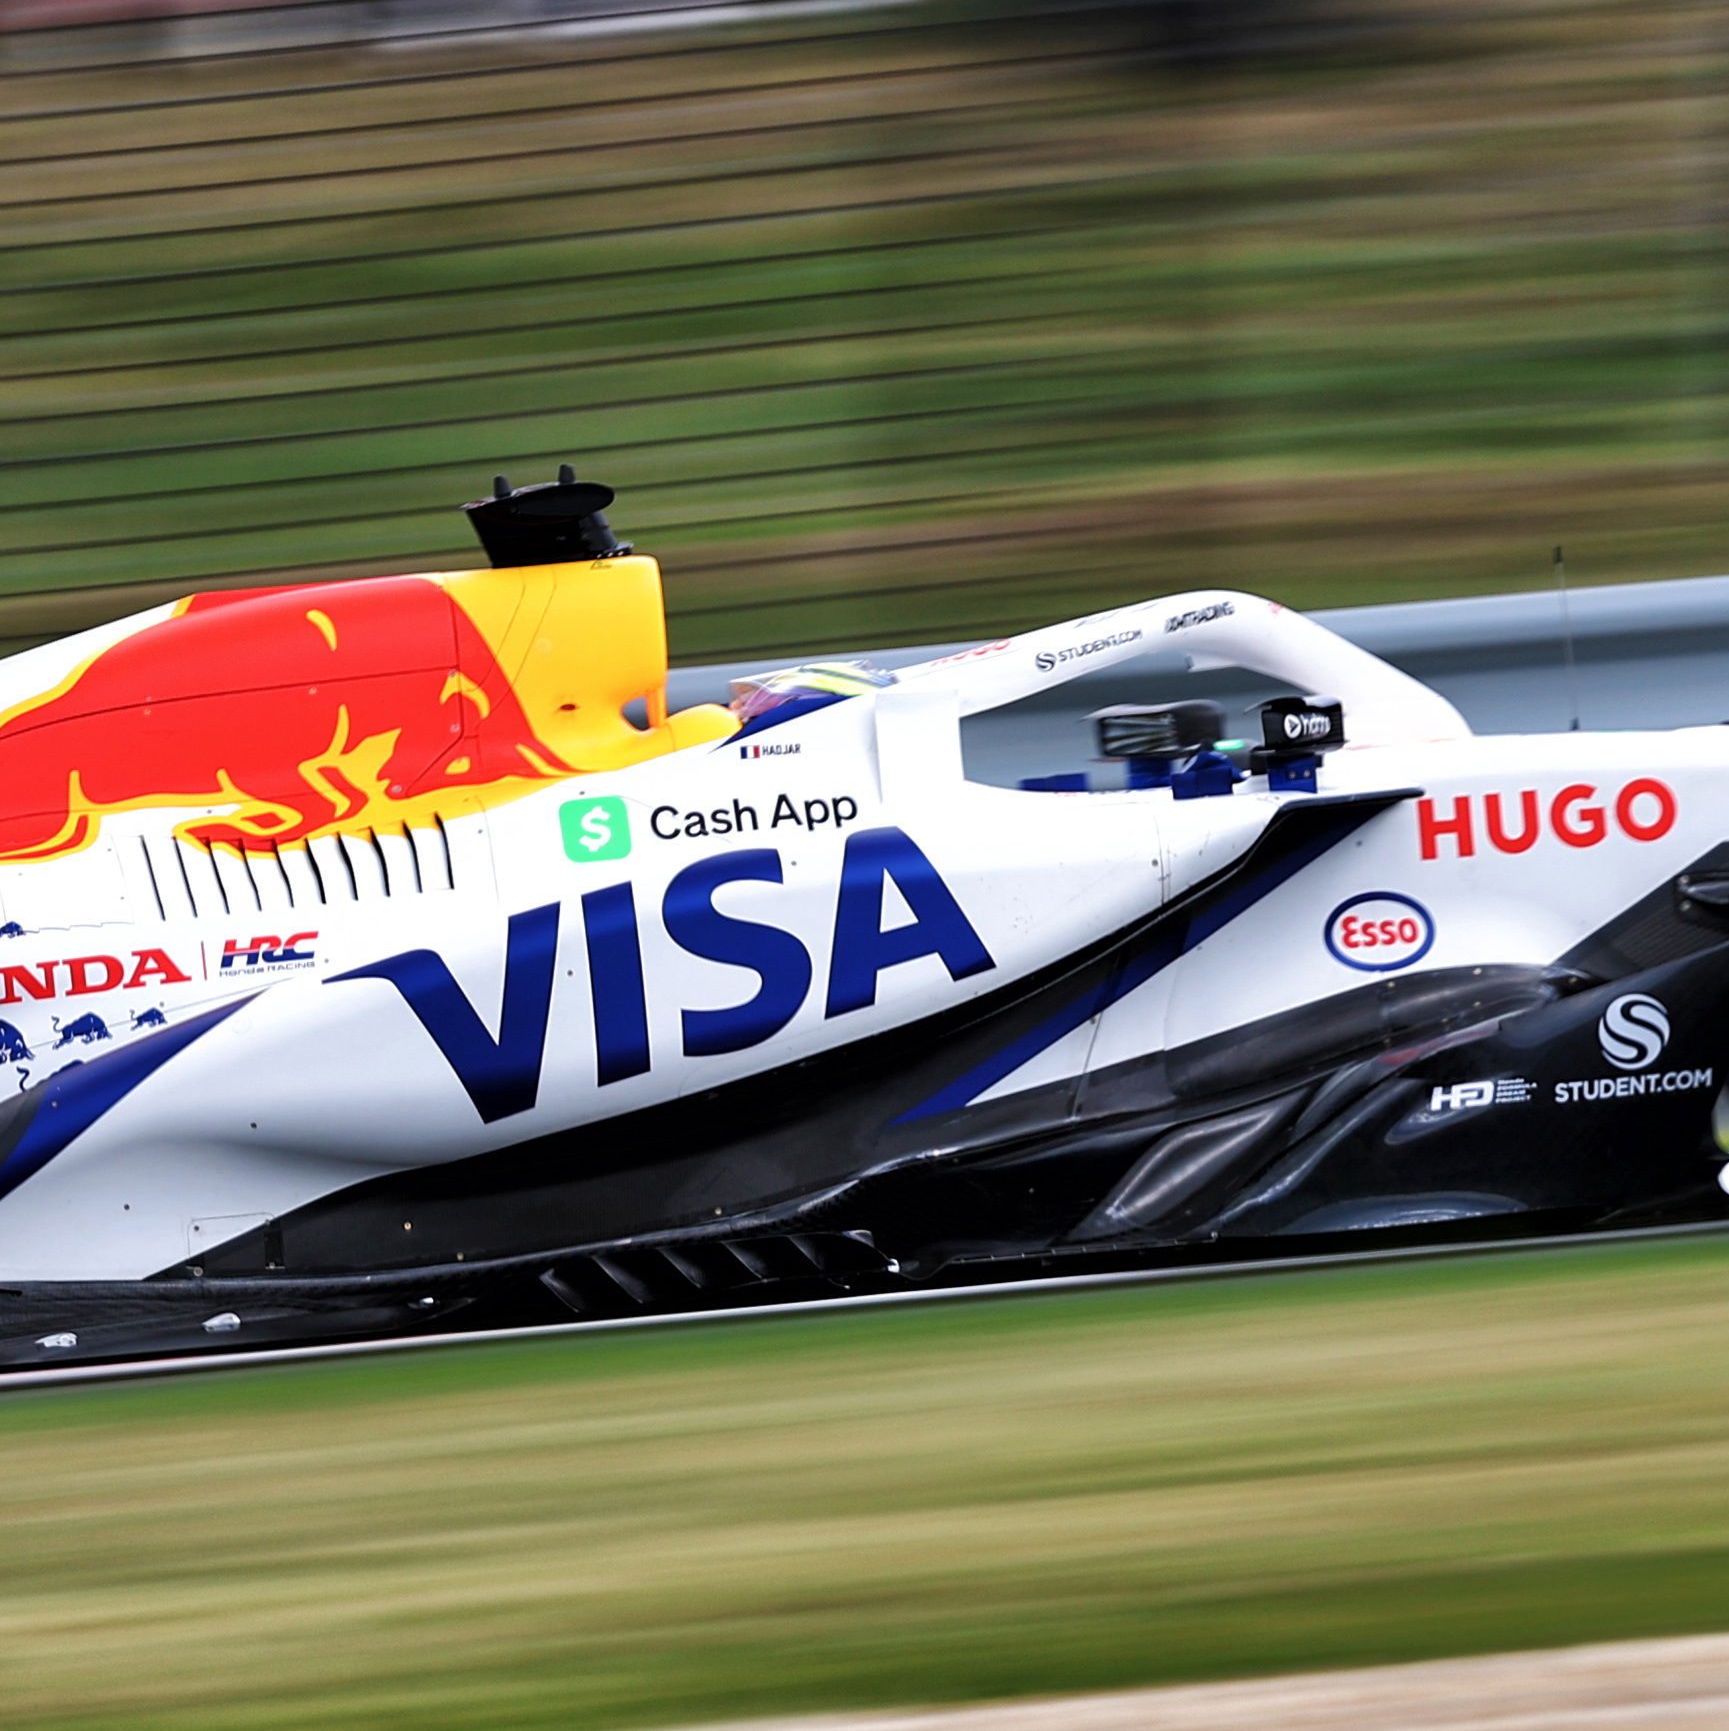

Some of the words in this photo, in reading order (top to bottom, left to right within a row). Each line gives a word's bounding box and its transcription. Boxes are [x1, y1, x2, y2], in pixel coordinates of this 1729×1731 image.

[762, 743, 801, 756] HADJAR
[650, 798, 759, 840] Cash
[771, 793, 858, 832] App
[1416, 778, 1677, 861] HUGO
[220, 930, 319, 968] HRC
[1340, 915, 1419, 949] Esso
[219, 967, 265, 977] Honda
[267, 961, 315, 972] RACING
[321, 826, 997, 1124] VISA
[1554, 1068, 1713, 1103] STUDENT.COM
